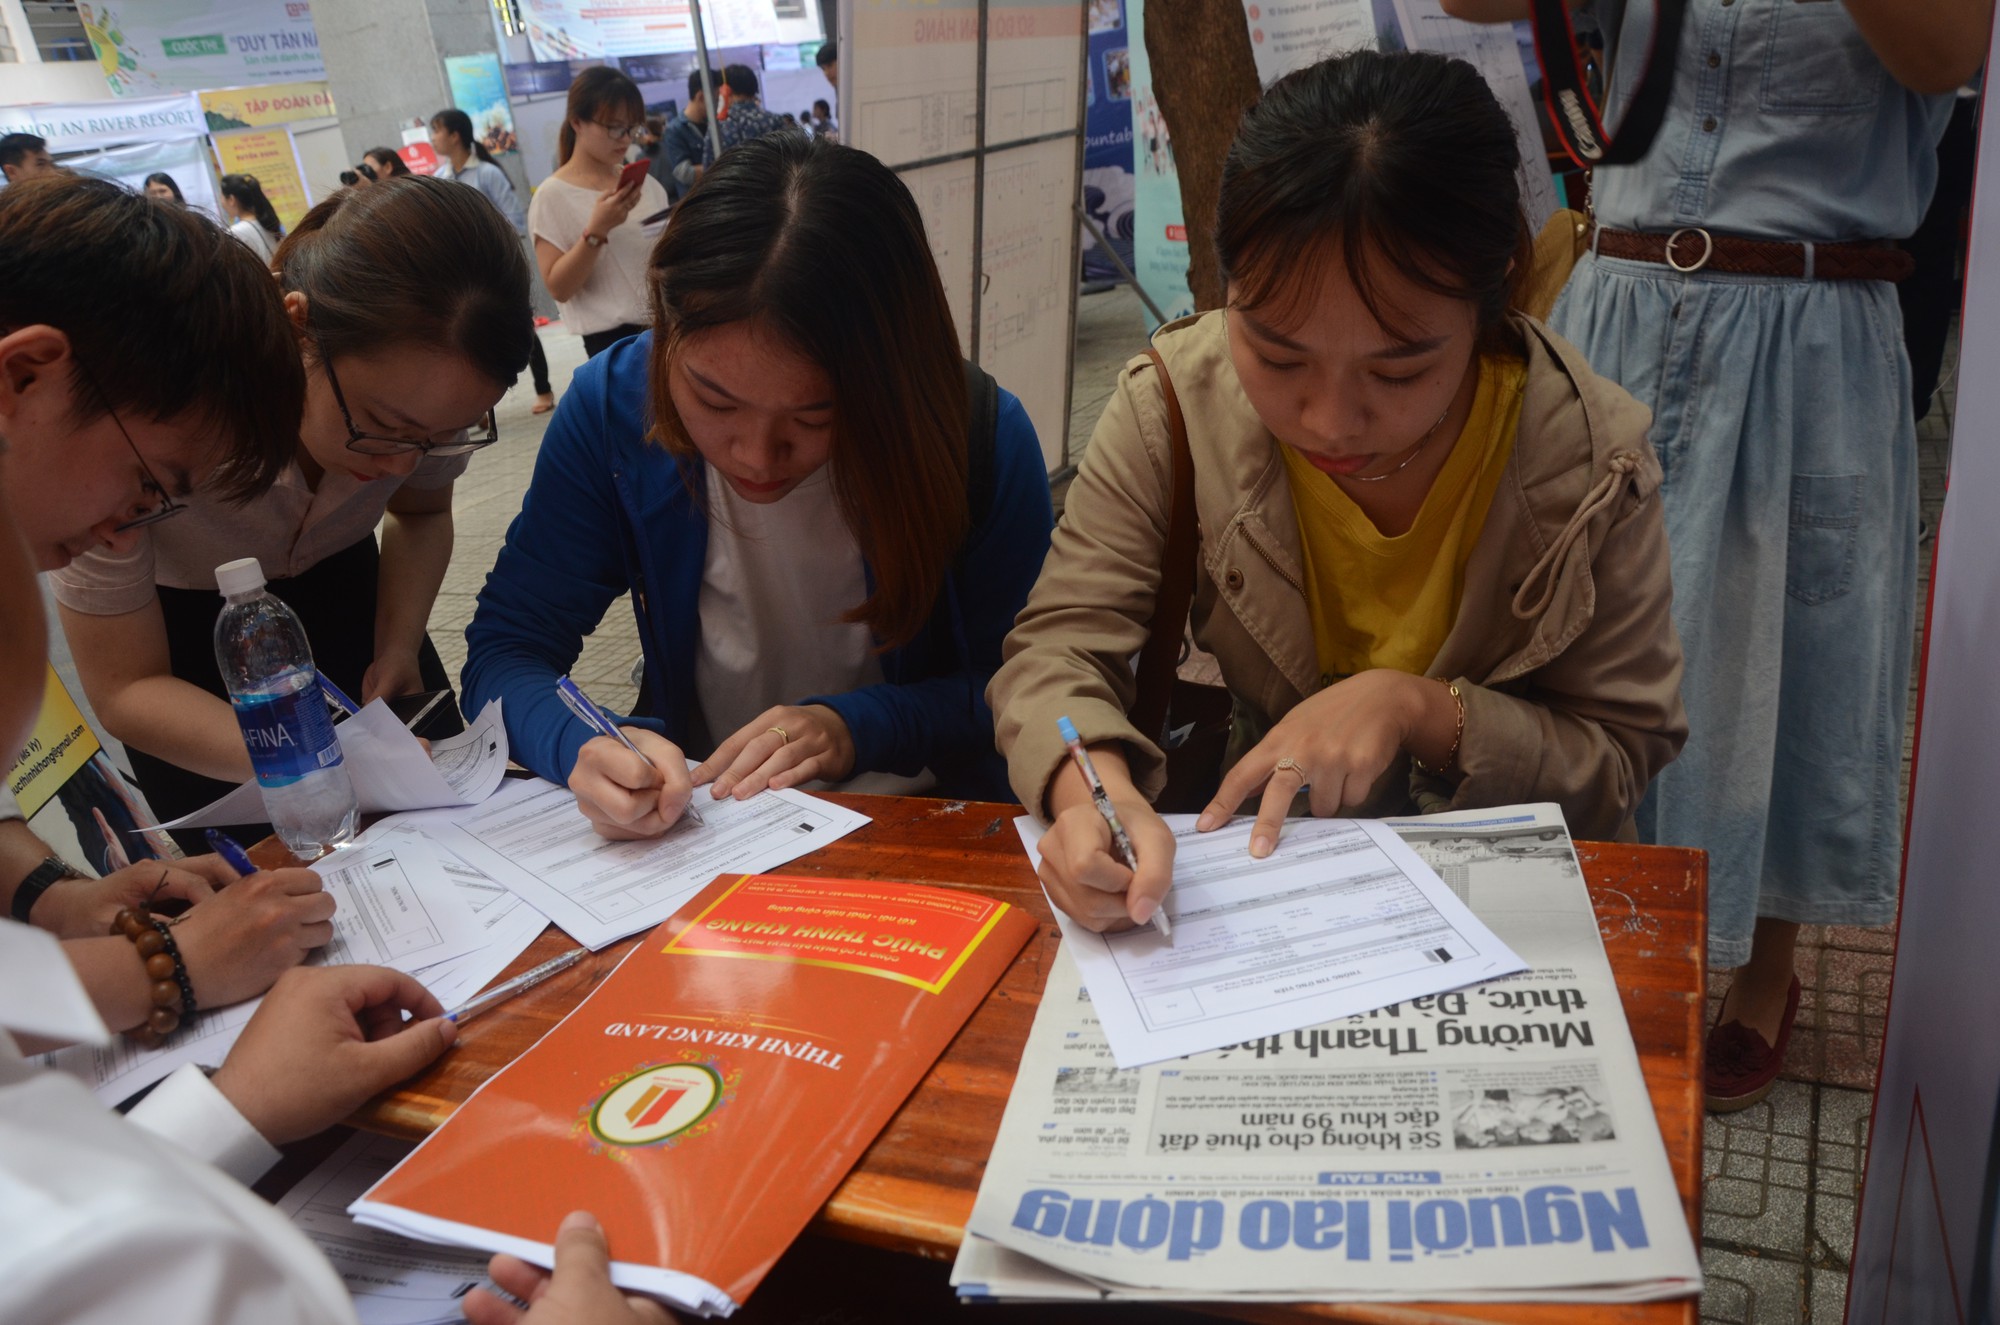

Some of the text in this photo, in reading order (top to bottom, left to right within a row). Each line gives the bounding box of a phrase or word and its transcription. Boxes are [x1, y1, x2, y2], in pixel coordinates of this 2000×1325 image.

[61, 120, 84, 136] AN
[89, 115, 139, 133] RIVER
[140, 110, 195, 128] RESORT
[706, 918, 948, 960] PHÚC THỊNH KHANG
[1410, 992, 1469, 1018] Đà
[1478, 987, 1588, 1016] thức,
[604, 1022, 844, 1070] THỊNH KHANG LAND
[1294, 1026, 1428, 1058] Thanh
[1436, 1018, 1594, 1052] Mường
[1240, 1108, 1440, 1130] đặc khu 99 năm
[1158, 1128, 1442, 1153] Sẽ không cho thuê đất
[1330, 1173, 1428, 1185] THỨ SÁU
[1010, 1184, 1650, 1262] Người lao động
